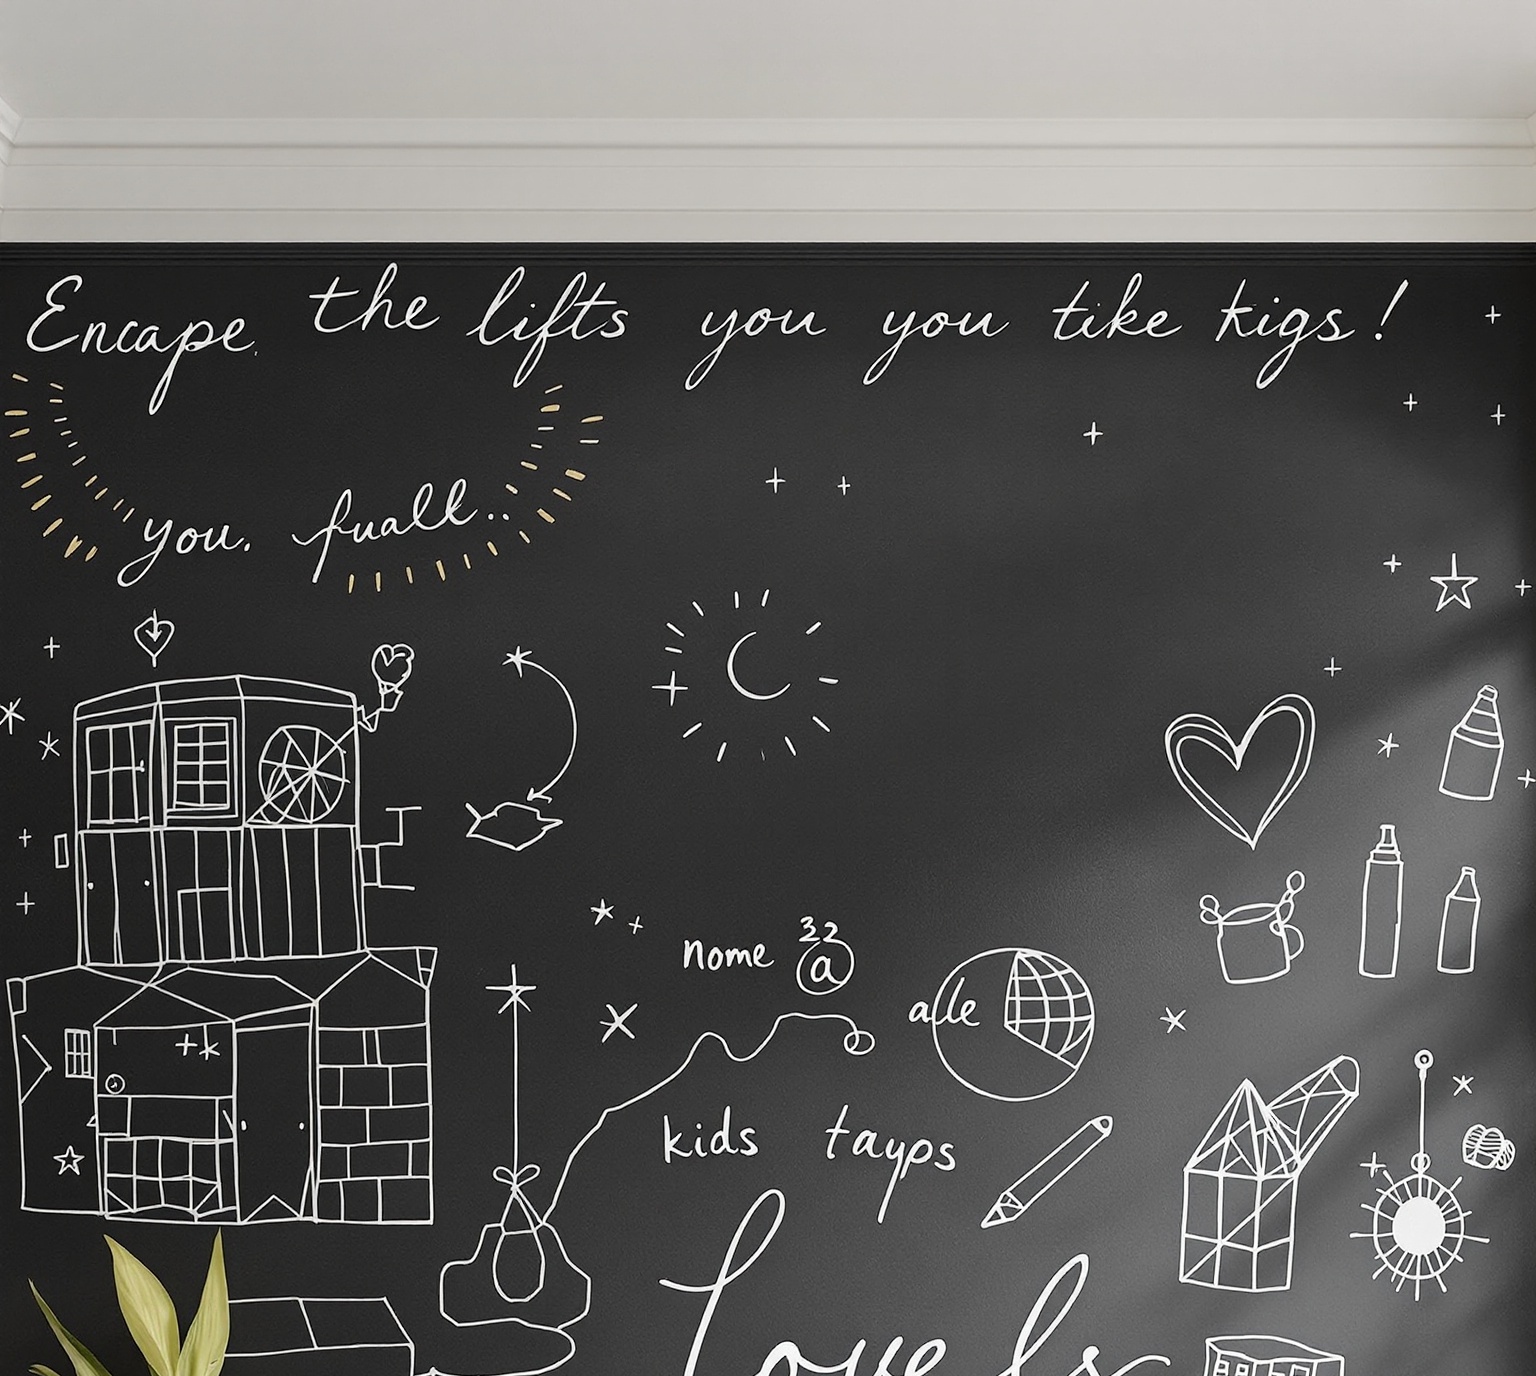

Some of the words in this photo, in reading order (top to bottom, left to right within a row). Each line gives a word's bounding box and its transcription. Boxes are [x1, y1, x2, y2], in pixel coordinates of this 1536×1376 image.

[308, 262, 440, 333] the
[466, 266, 629, 388] lifts
[685, 307, 827, 391] you
[862, 310, 1010, 386] you
[1051, 272, 1183, 341] tike
[663, 1105, 759, 1164] kids
[825, 1104, 956, 1224] tayps
